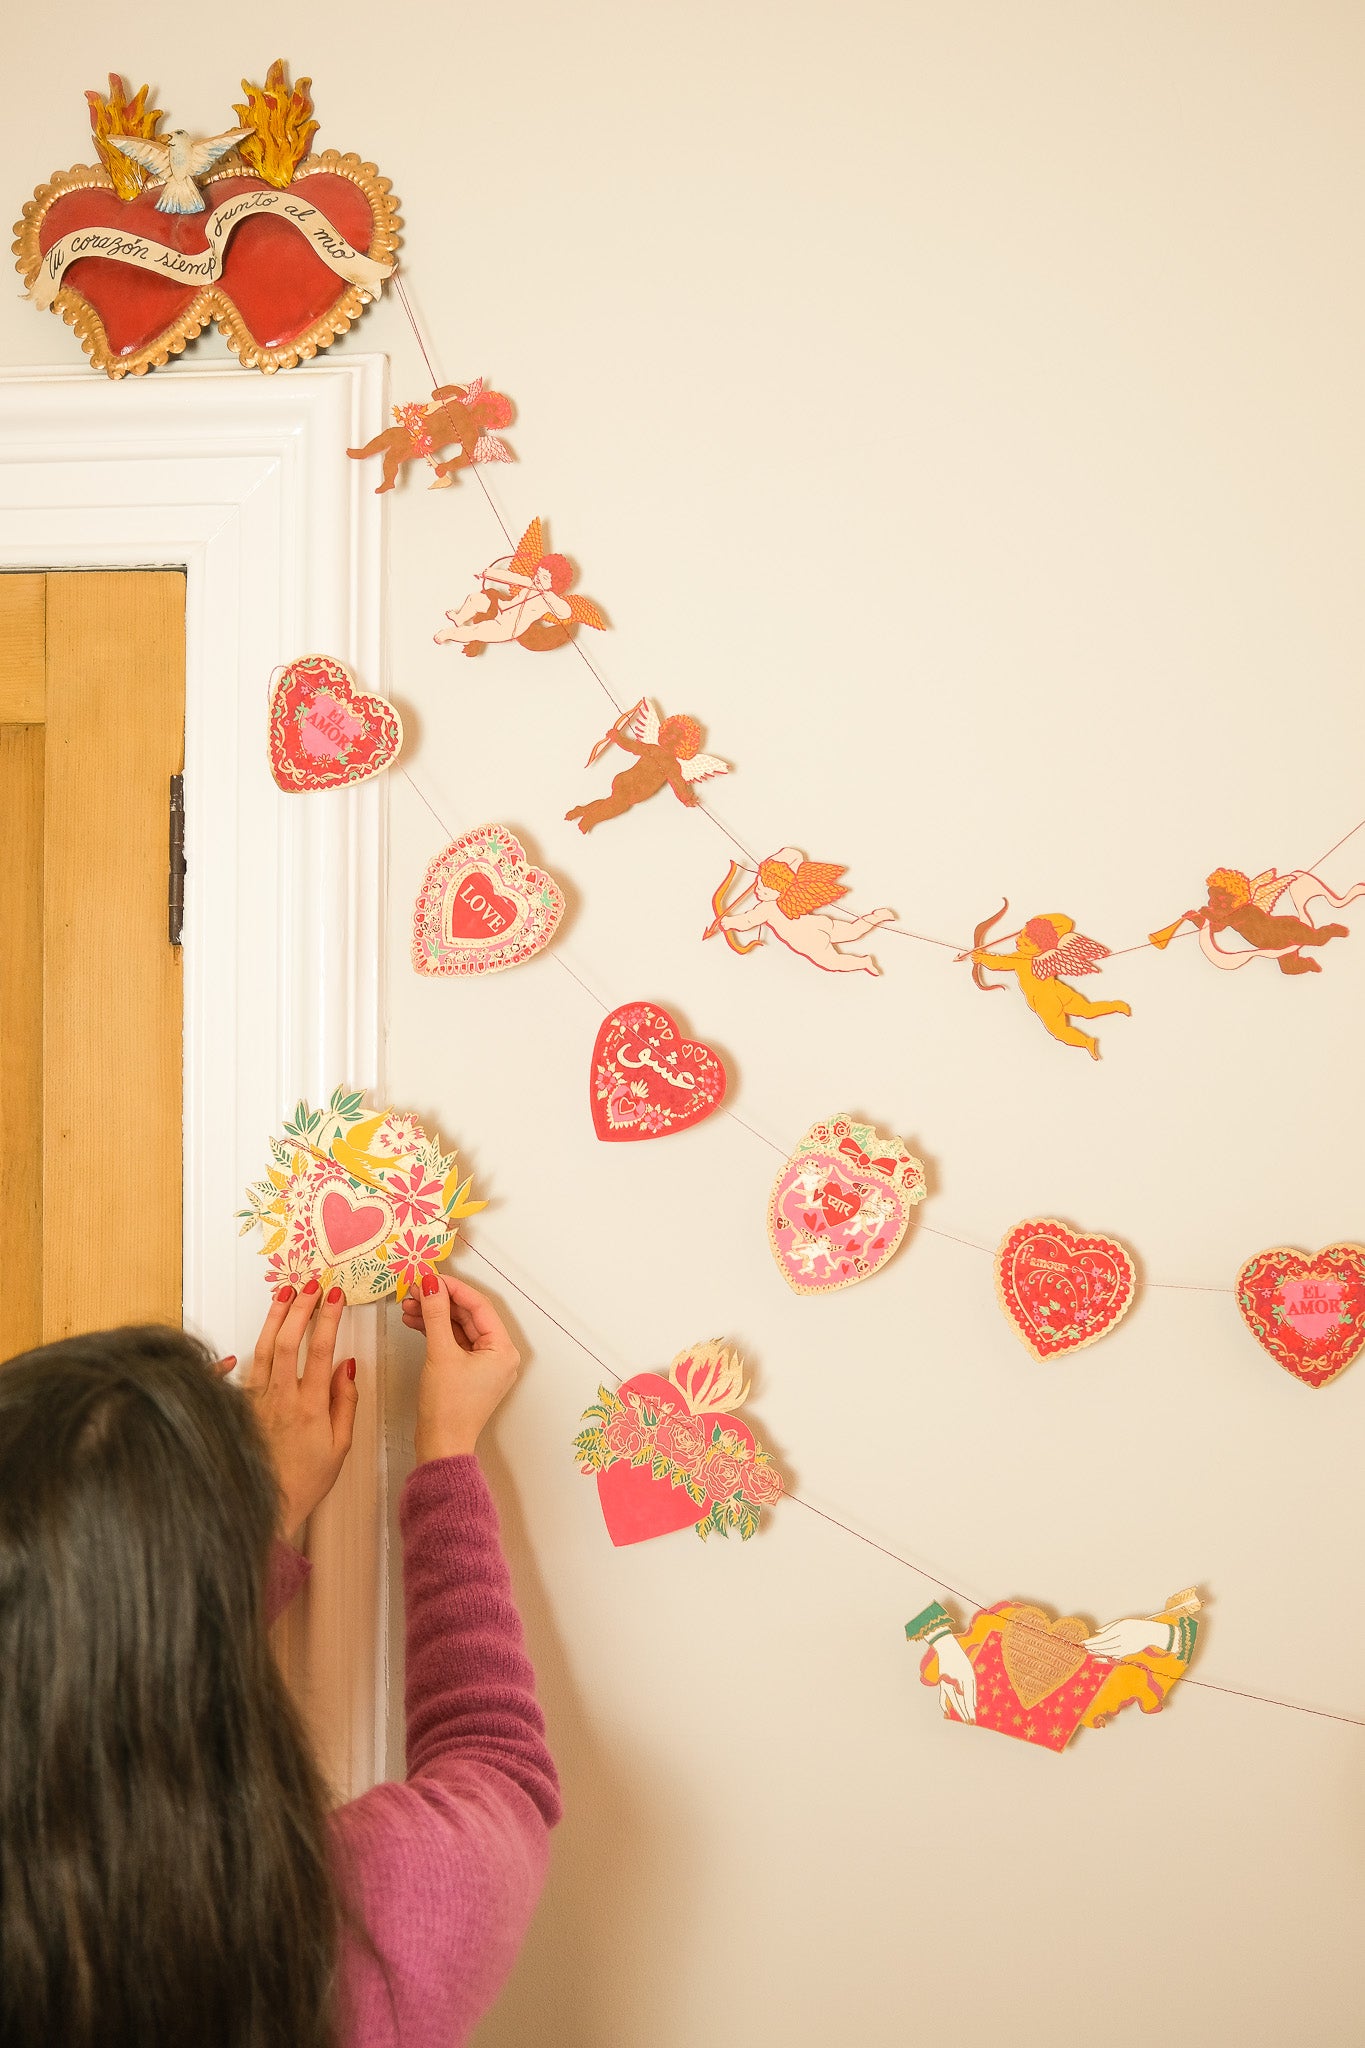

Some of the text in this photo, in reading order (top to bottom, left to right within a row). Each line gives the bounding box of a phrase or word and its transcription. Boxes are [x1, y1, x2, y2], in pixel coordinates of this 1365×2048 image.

[214, 191, 279, 237] junto
[284, 206, 316, 221] al
[45, 239, 64, 279] Tu
[71, 234, 149, 260] corazón
[305, 712, 351, 751] AMOR
[326, 709, 345, 730] EL
[459, 884, 507, 933] LOVE
[827, 1194, 853, 1217] प्यार
[1286, 1299, 1342, 1315] AMOR
[1302, 1285, 1326, 1299] EL
